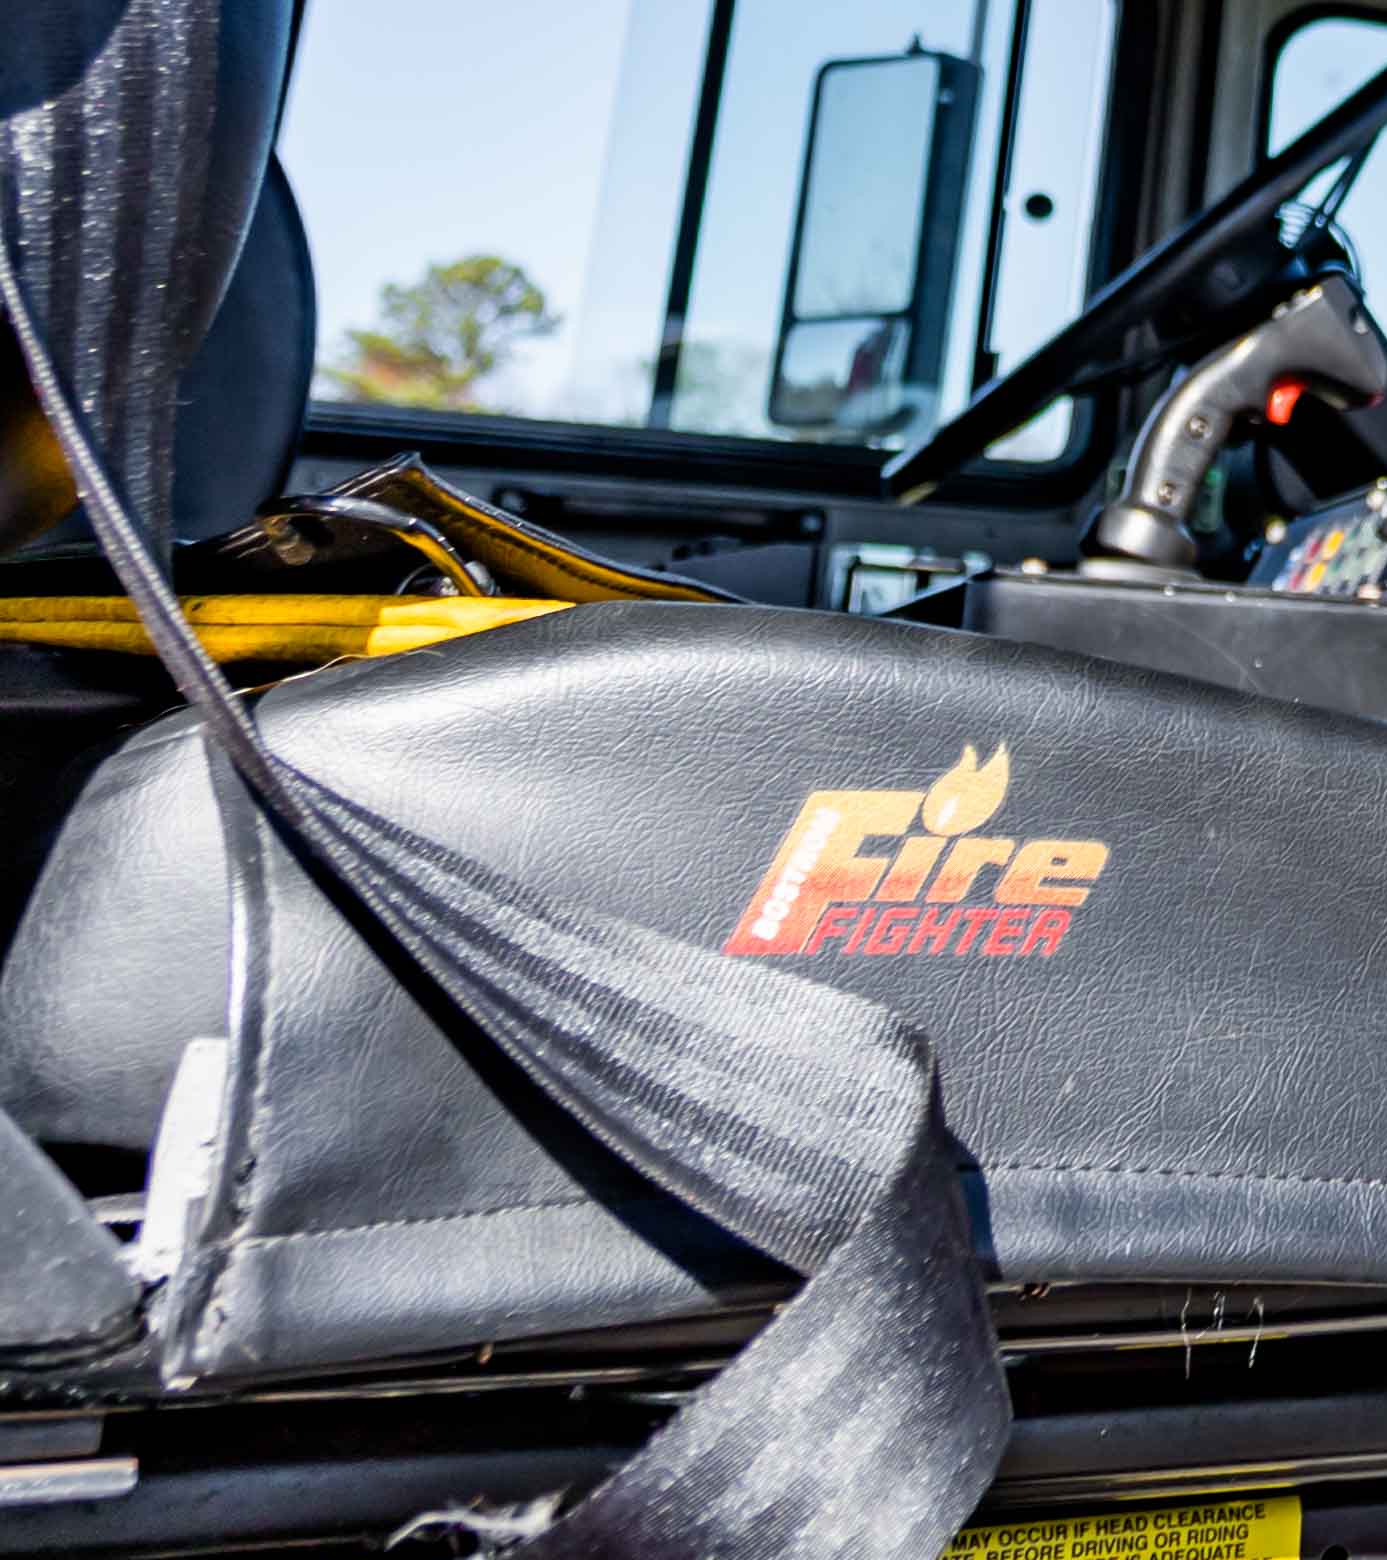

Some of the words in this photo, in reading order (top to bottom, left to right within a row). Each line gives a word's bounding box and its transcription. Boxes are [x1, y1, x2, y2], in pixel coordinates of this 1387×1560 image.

[725, 740, 1112, 956] Fire
[804, 906, 1075, 956] FIGHTER
[951, 1531, 992, 1553] MAY
[999, 1525, 1068, 1546] OCCUR
[1074, 1520, 1091, 1538] IF
[1095, 1514, 1148, 1536] HEAD
[1153, 1503, 1266, 1529] CLEARANCE
[1071, 1534, 1148, 1557] DRIVING
[1154, 1530, 1180, 1549] OR
[1187, 1523, 1249, 1545] RIDING
